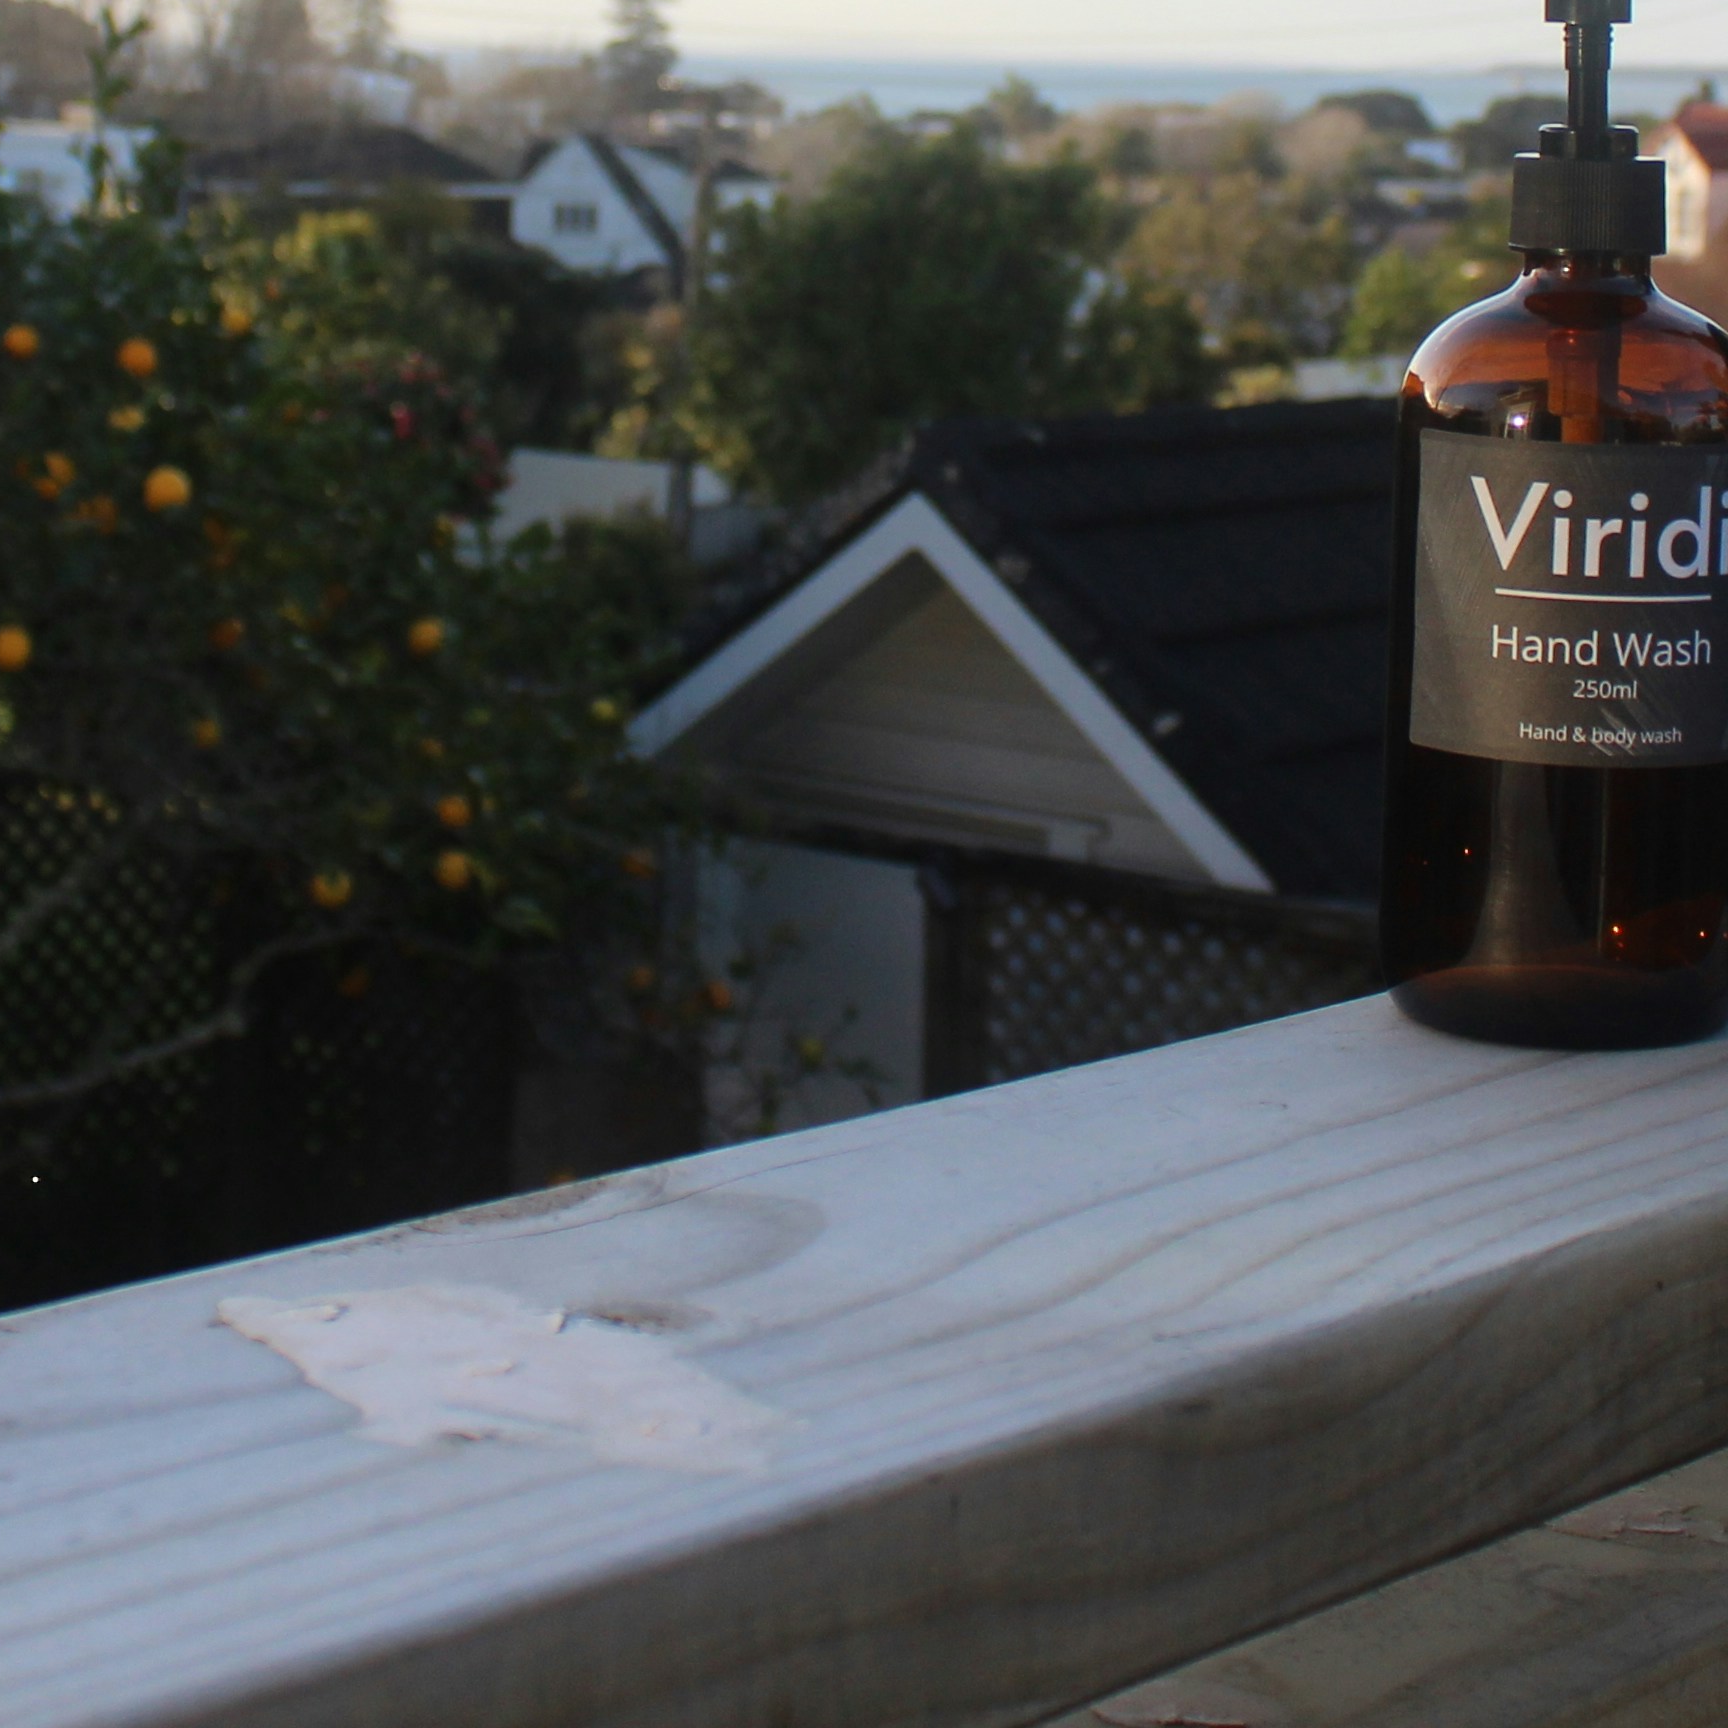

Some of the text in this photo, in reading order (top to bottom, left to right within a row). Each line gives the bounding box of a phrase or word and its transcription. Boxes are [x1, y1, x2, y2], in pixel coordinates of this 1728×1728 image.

[1491, 623, 1712, 667] Hand Wash
[1572, 679, 1638, 700] 250ml
[1518, 722, 1683, 748] Hand & body wash
